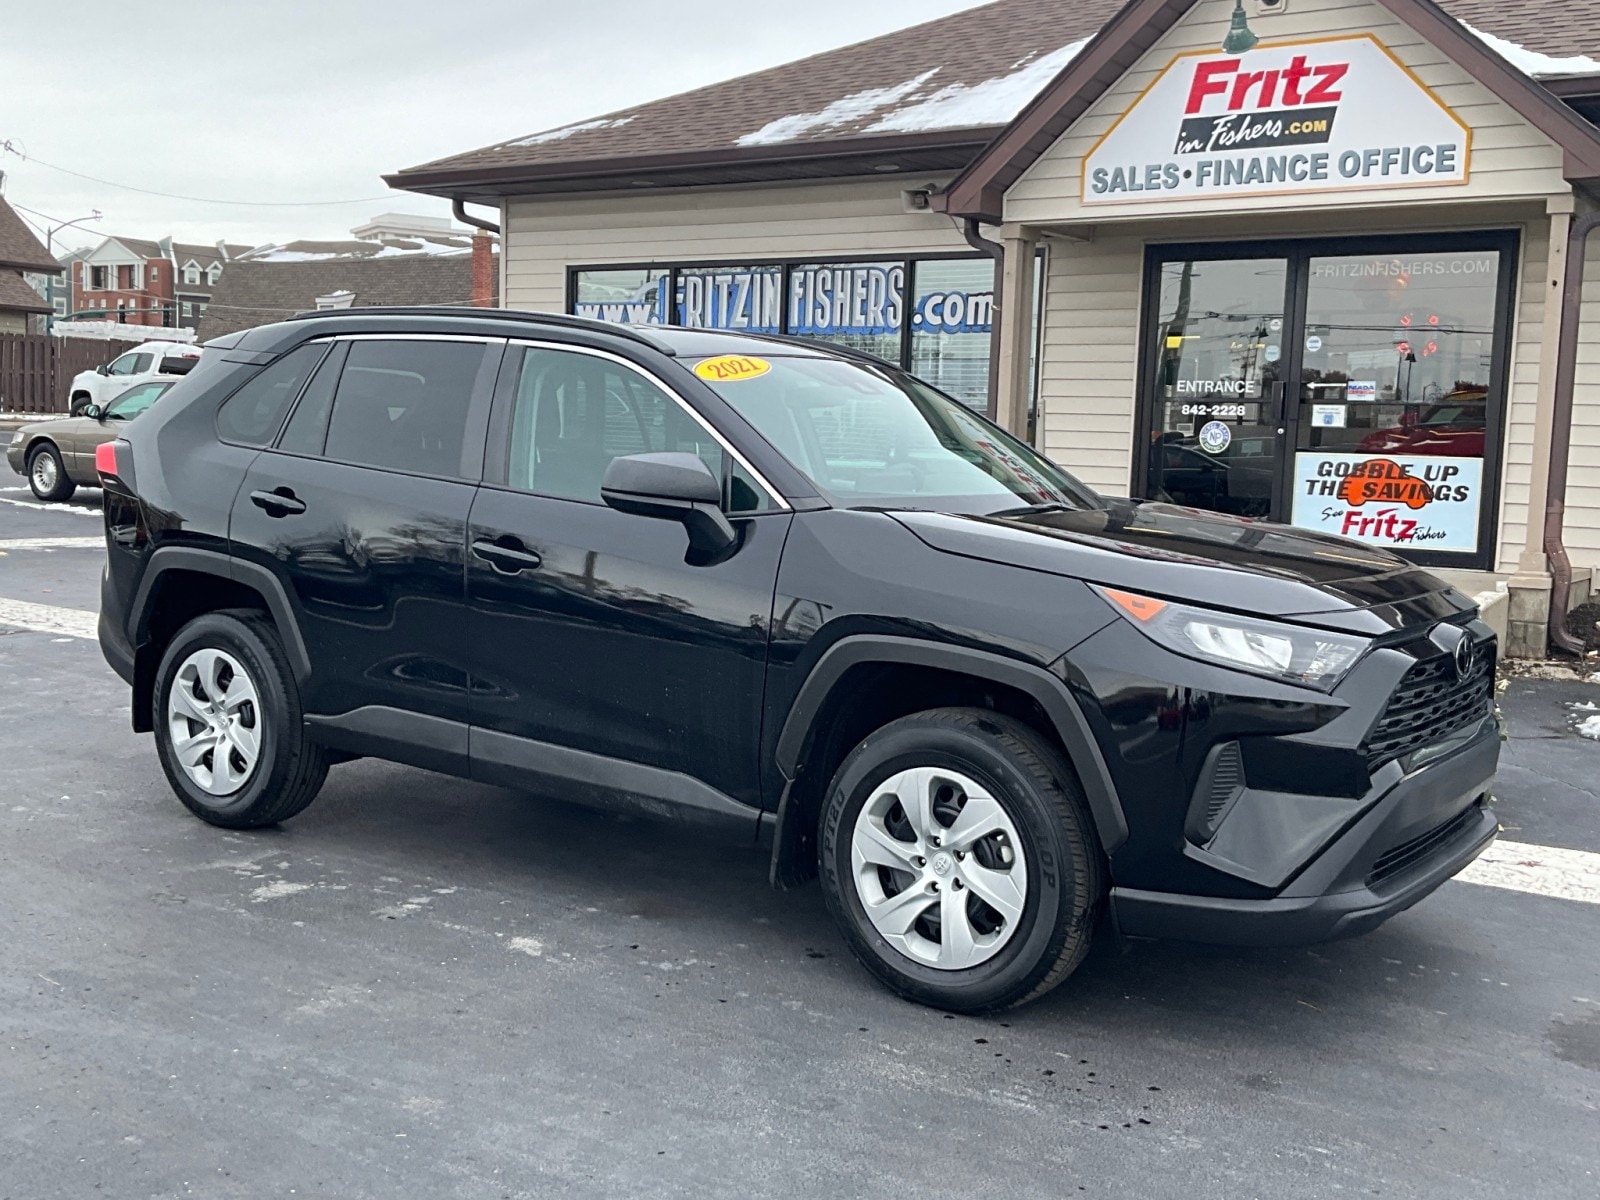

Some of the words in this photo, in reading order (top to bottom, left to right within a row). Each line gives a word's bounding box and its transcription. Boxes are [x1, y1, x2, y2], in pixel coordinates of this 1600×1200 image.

[1184, 56, 1349, 114] Fritz
[1178, 131, 1203, 154] in
[1207, 114, 1283, 152] Fishers
[1092, 163, 1180, 194] SALES
[1196, 152, 1329, 187] FINANCE
[1338, 144, 1456, 178] OFFICE
[1316, 259, 1490, 278] FRITZINFISHERS.COM
[706, 358, 762, 378] 2021
[1176, 380, 1255, 393] ENTRANCE
[1181, 404, 1246, 416] 842-2228
[1317, 461, 1413, 480] GOBBLE
[1424, 465, 1459, 482] UP
[1305, 480, 1352, 497] THE
[1362, 481, 1470, 502] SAVINGS
[1321, 507, 1344, 521] See
[1341, 508, 1417, 539] Fritz
[1409, 526, 1447, 543] Fishers
